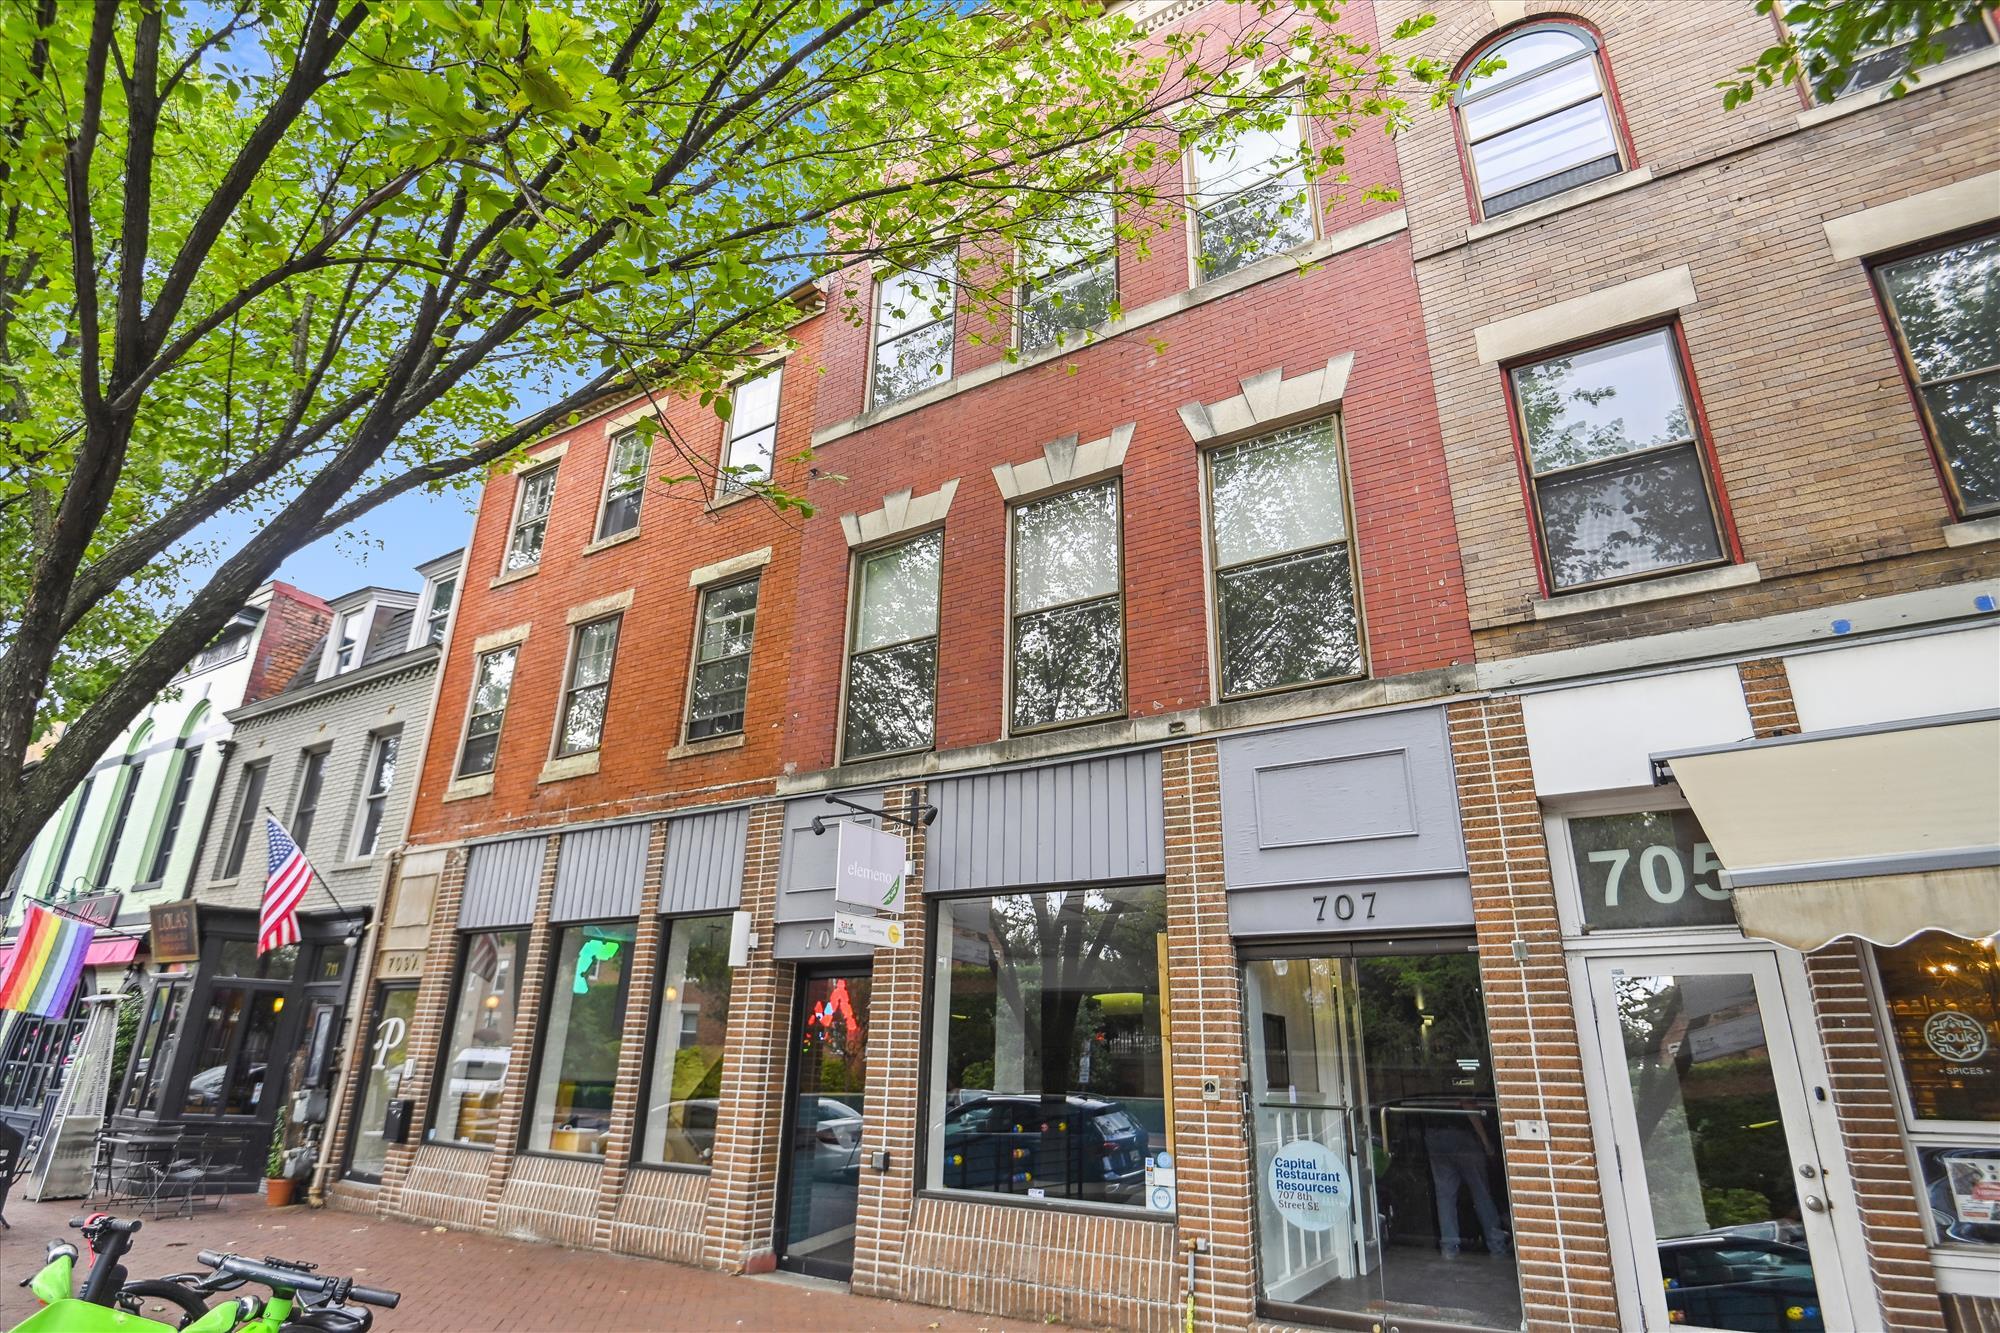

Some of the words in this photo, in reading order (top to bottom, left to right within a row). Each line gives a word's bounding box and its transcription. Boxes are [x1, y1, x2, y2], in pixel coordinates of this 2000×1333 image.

[848, 861, 892, 883] elemeno
[1588, 842, 1731, 907] 705
[1312, 891, 1377, 921] 707
[805, 928, 846, 949] 70
[371, 1017, 406, 1070] P
[1946, 1067, 1984, 1075] SPICES
[1275, 1157, 1316, 1170] Capital
[1276, 1168, 1340, 1181] Restaurant
[1277, 1180, 1338, 1194] Resources
[1278, 1191, 1294, 1199] 707
[1297, 1191, 1312, 1200] 8th
[1278, 1199, 1305, 1210] Street
[1308, 1202, 1319, 1210] SE
